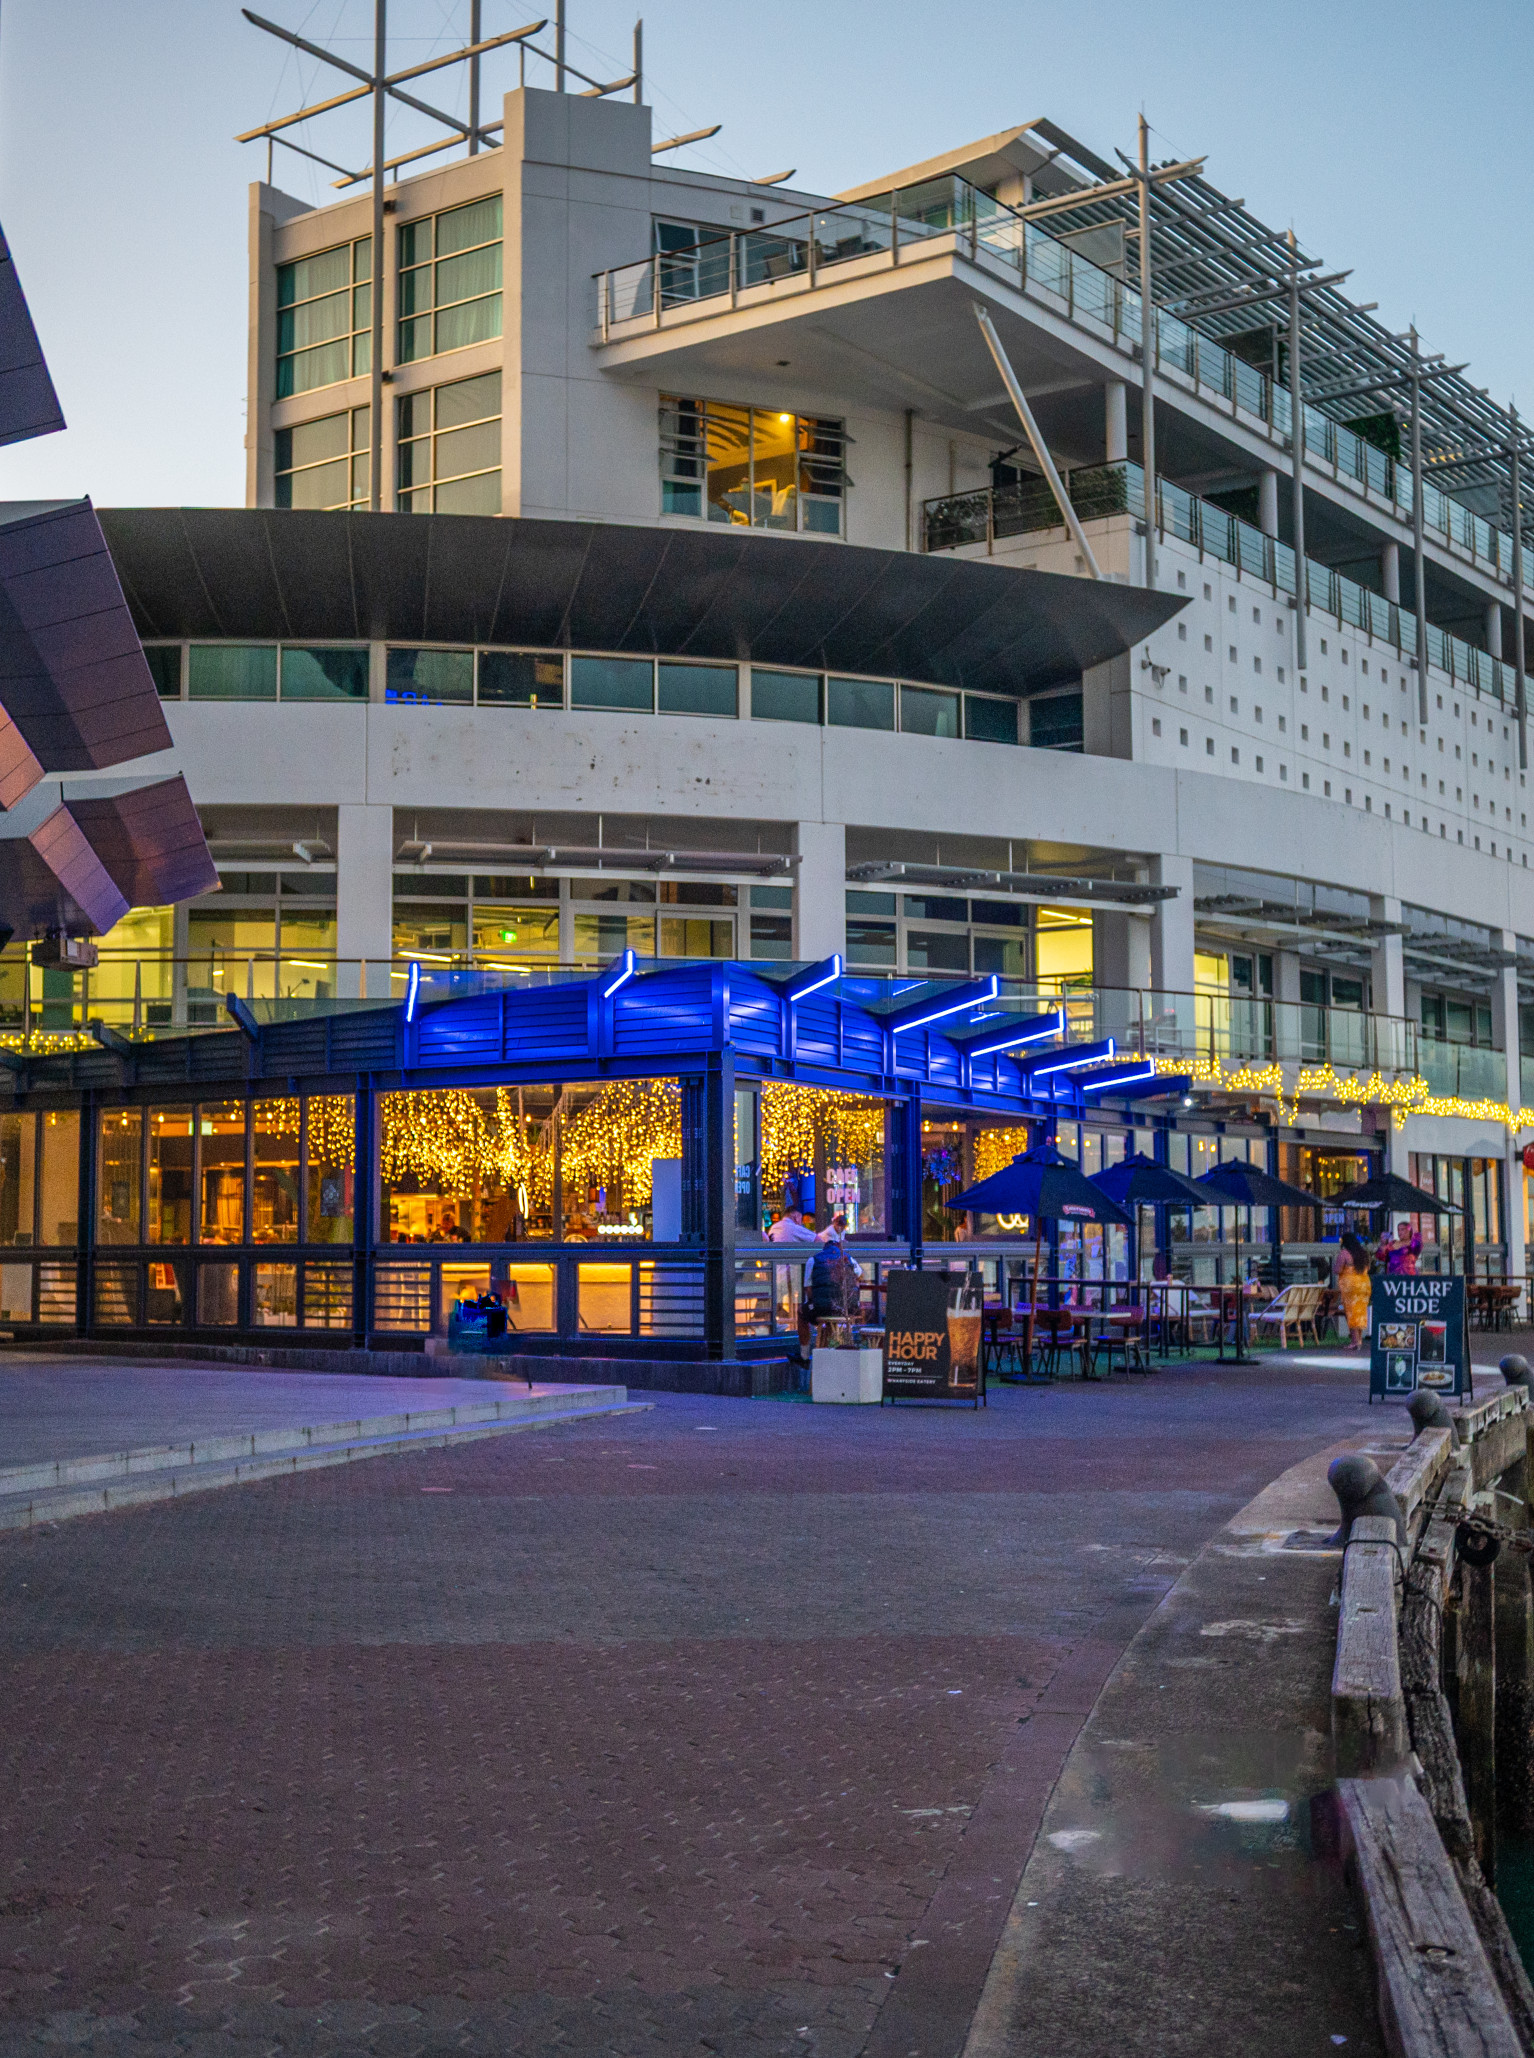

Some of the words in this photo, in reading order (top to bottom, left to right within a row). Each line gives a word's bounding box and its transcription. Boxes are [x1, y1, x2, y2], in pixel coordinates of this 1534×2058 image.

[826, 1168, 858, 1184] CAFE
[826, 1188, 860, 1204] OPEN
[1382, 1281, 1453, 1297] WHARF
[1395, 1298, 1440, 1314] SIDE
[889, 1331, 945, 1347] HAPPY
[888, 1345, 938, 1360] HOUR
